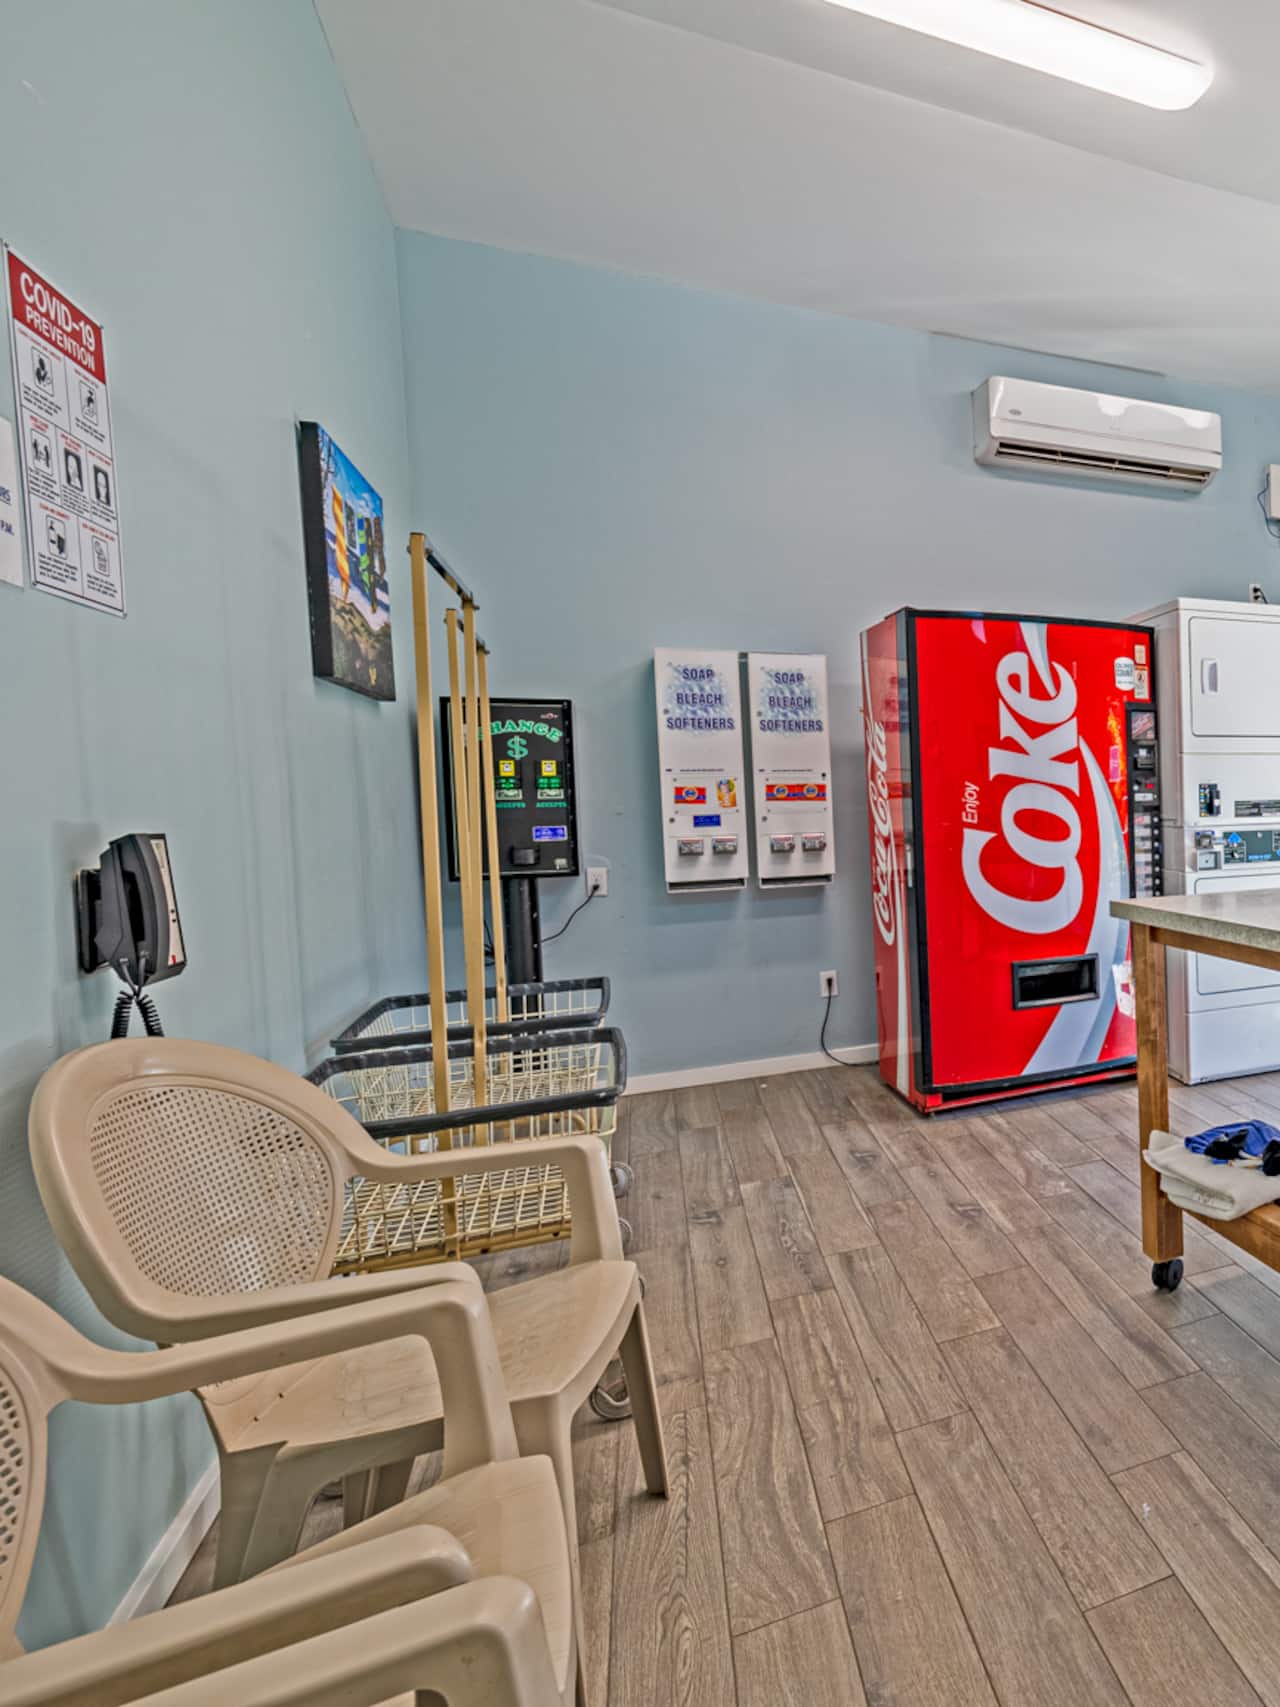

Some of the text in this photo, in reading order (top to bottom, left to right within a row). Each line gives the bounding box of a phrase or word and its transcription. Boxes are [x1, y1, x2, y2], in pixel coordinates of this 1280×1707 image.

[20, 271, 96, 352] COVID-19
[25, 304, 96, 372] PREVENTION
[682, 668, 714, 681] SOAP
[774, 672, 804, 684] SOAP
[676, 693, 722, 705] BLEACH
[768, 696, 812, 708] BLEACH
[478, 719, 564, 743] HANGE
[666, 718, 735, 730] SOFTENERS
[759, 720, 823, 732] SOFTENERS
[961, 650, 1084, 935] Coke
[961, 781, 980, 825] Enjoy
[866, 718, 896, 945] Coca-Cola
